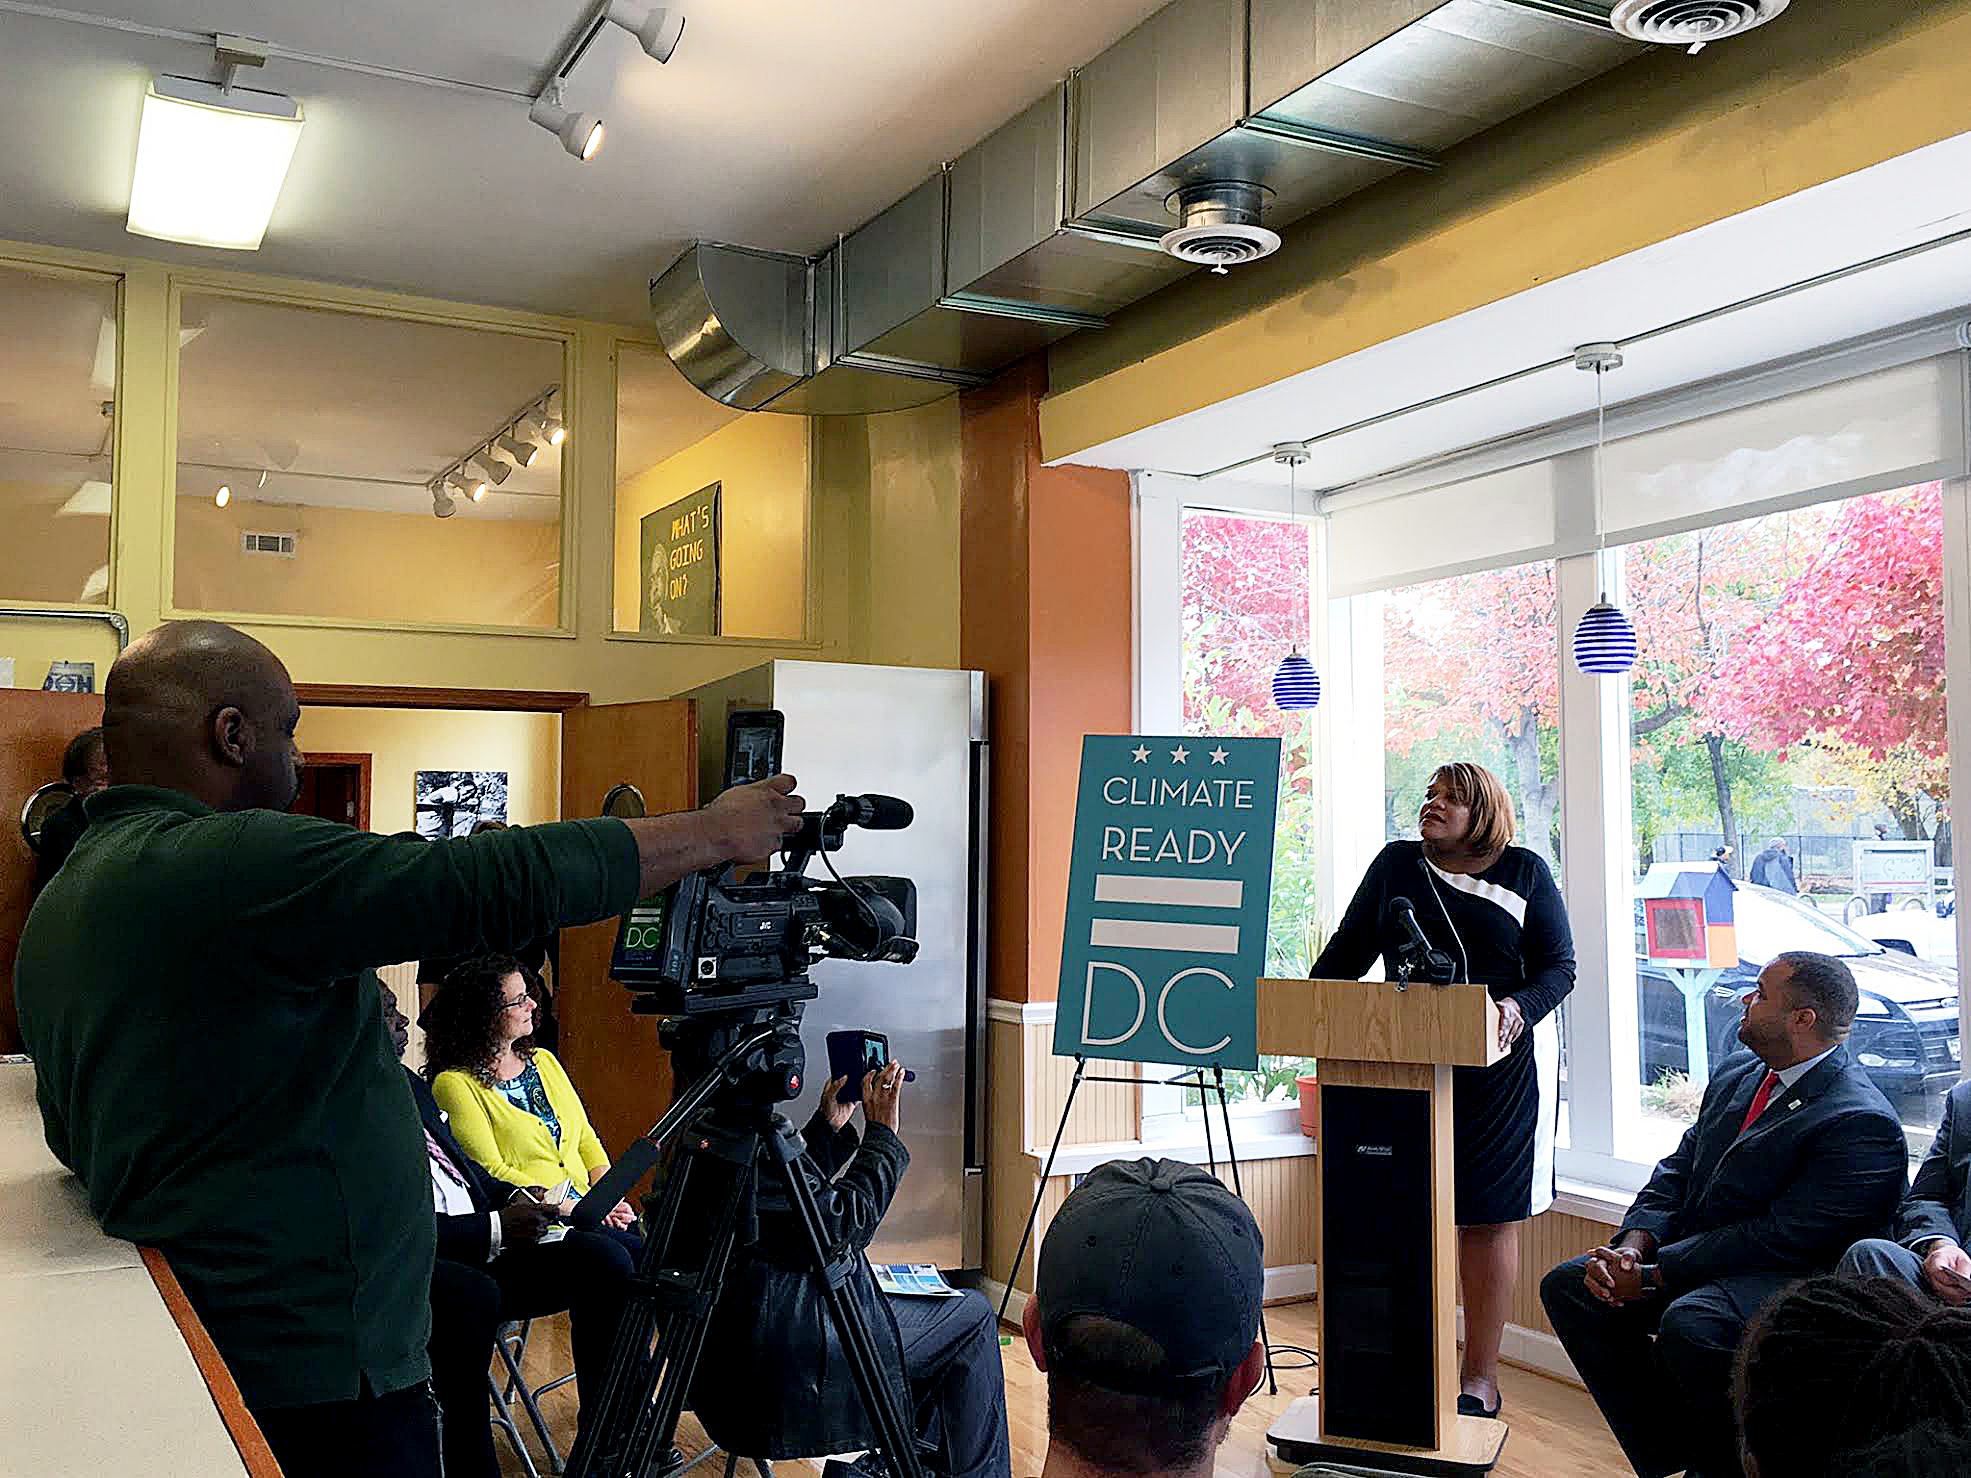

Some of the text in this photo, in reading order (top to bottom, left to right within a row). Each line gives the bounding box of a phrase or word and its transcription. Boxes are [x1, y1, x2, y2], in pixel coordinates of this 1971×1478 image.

[671, 505, 710, 541] WHAT'S
[670, 539, 704, 570] GOING
[669, 574, 689, 600] ON?
[1103, 776, 1255, 809] CLIMATE
[1101, 826, 1247, 865] READY
[626, 927, 659, 948] DC
[1080, 961, 1235, 1054] DC
